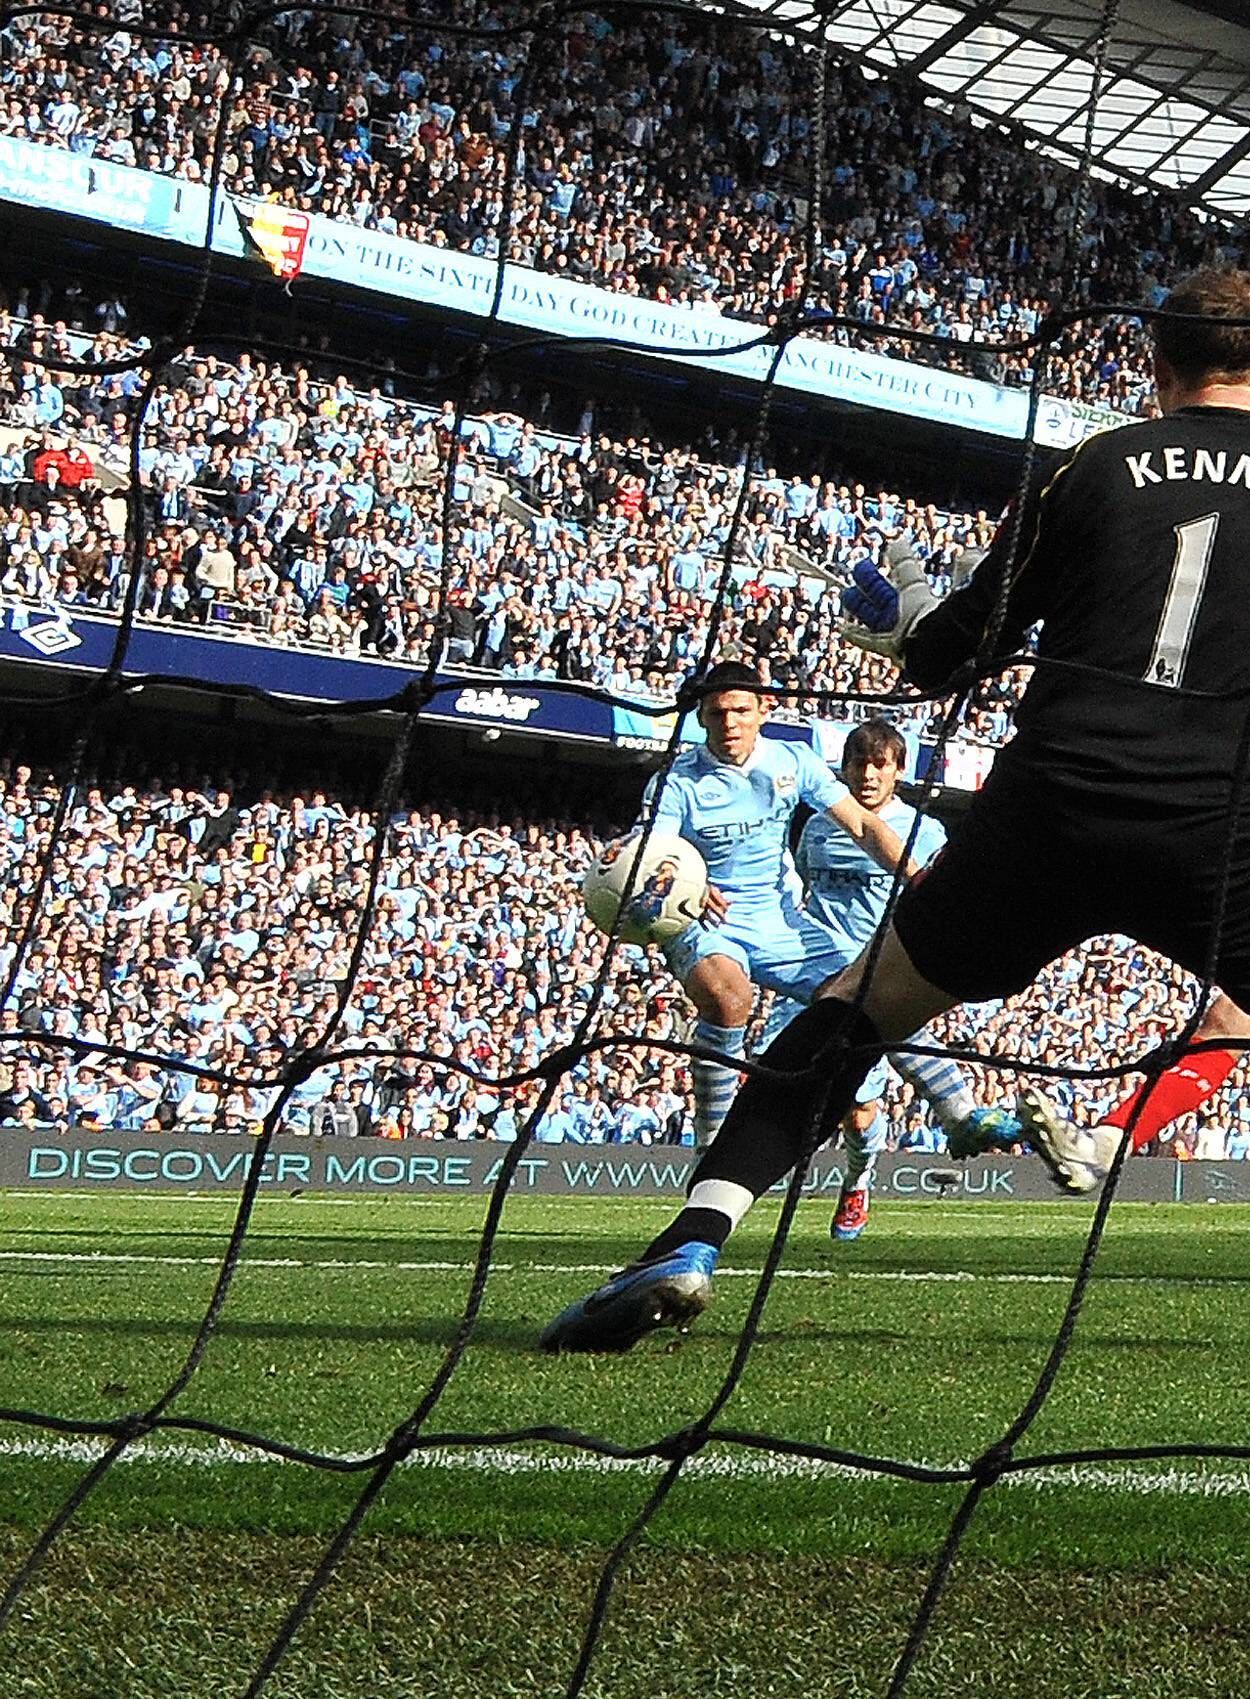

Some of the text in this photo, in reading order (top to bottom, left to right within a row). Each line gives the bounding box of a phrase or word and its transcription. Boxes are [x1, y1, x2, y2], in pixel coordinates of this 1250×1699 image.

[309, 236, 348, 256] ON
[356, 245, 413, 275] THE
[512, 285, 562, 310] DAY
[633, 314, 744, 347] CREATE
[925, 382, 976, 409] CITY
[1141, 511, 1220, 689] 1
[29, 1147, 311, 1183] DISCOVER
[326, 1156, 472, 1185] MORE
